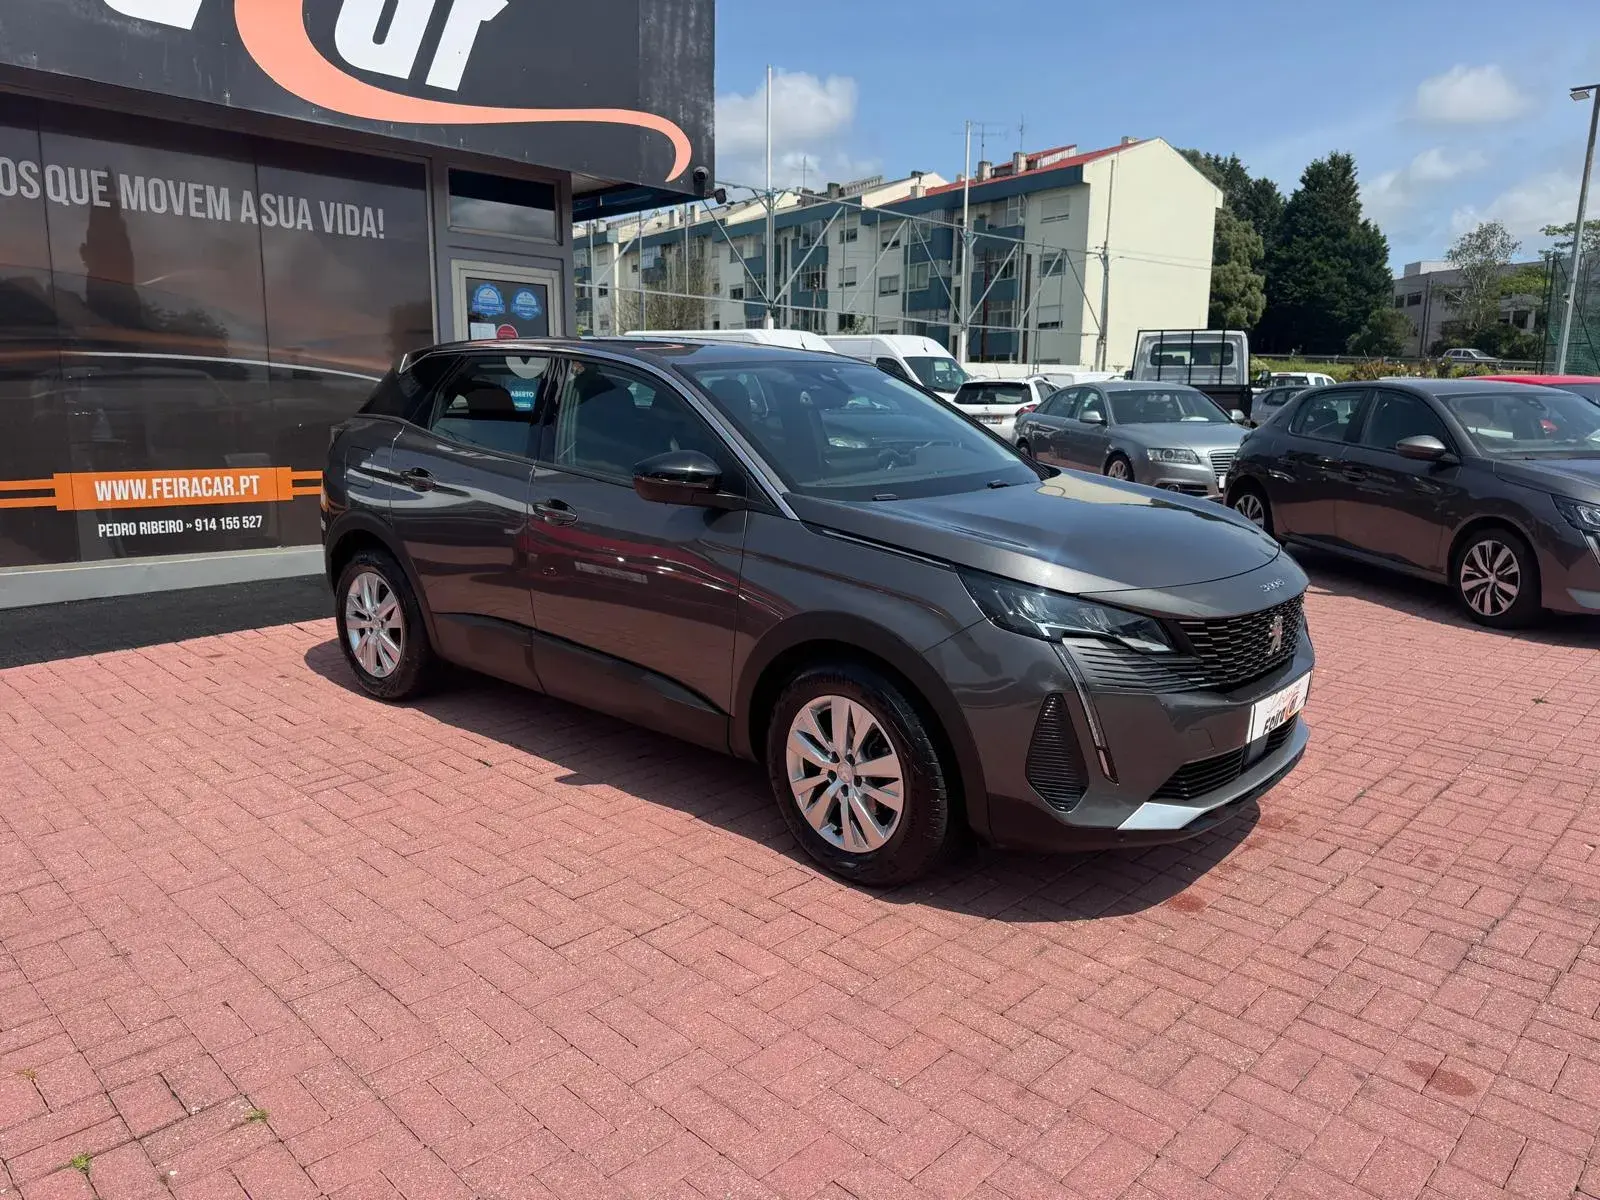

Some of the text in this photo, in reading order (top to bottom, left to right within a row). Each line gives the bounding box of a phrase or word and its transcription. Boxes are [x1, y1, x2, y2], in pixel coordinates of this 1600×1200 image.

[0, 156, 385, 240] OS QUE MOVEM A SUA VIDA!
[94, 475, 260, 502] WWW.FEIRACAR.PT
[98, 522, 137, 538] PEDRO
[139, 518, 184, 535] RIBEIRO
[195, 516, 217, 532] 914
[221, 515, 240, 531] 155
[242, 514, 263, 530] 527
